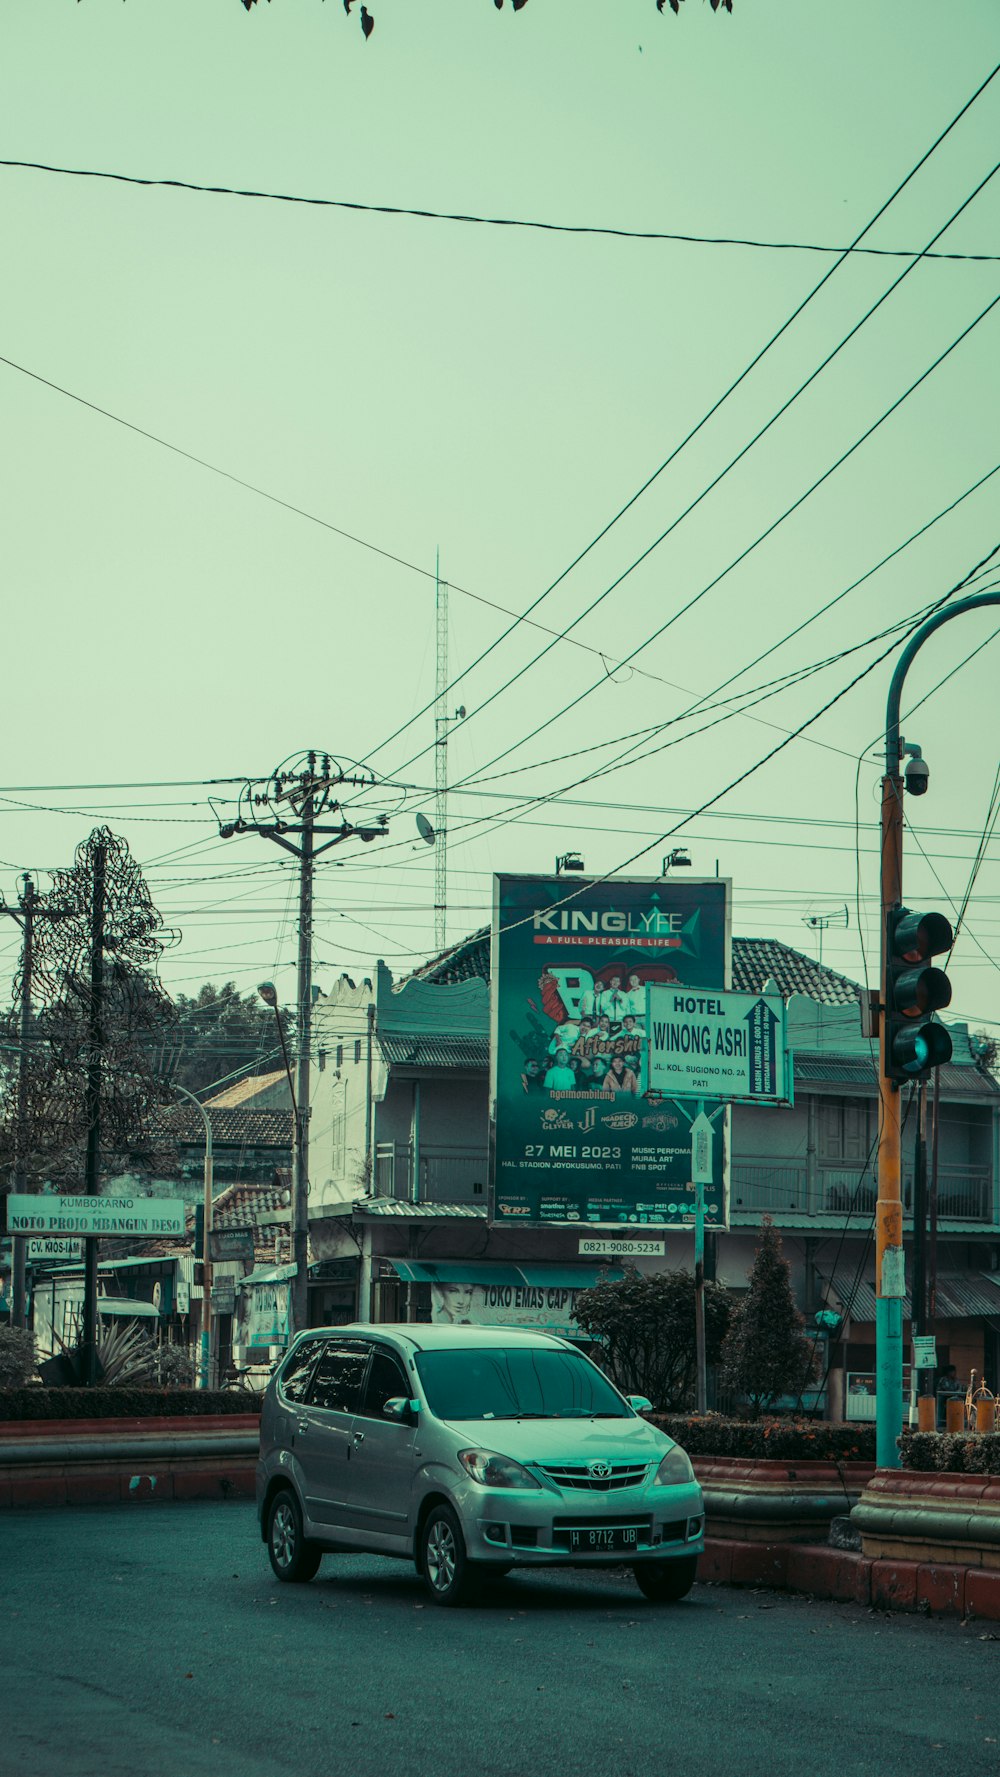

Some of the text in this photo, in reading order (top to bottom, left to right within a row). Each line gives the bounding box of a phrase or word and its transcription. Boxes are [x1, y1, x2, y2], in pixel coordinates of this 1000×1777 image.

[533, 909, 683, 933] KINGLYFE
[546, 936, 670, 946] A FULL PLEASURE LIFE
[674, 996, 726, 1016] HOTEL
[653, 1022, 747, 1057] WINONG ASRI
[654, 1063, 746, 1077] JL. KOL. SUGIONO NO. 2A
[525, 1145, 621, 1158] 27 MEI 2023
[60, 1198, 134, 1210] KUMBOKARNO
[12, 1216, 180, 1232] NOTO PROJO MBANGUN DESO
[31, 1241, 43, 1253] CV.
[584, 1242, 660, 1253] 0821-9080-5234
[484, 1287, 512, 1308] TOKO
[515, 1288, 544, 1309] EMAS
[548, 1288, 568, 1310] CAP
[572, 1530, 636, 1545] H 8712 UB
